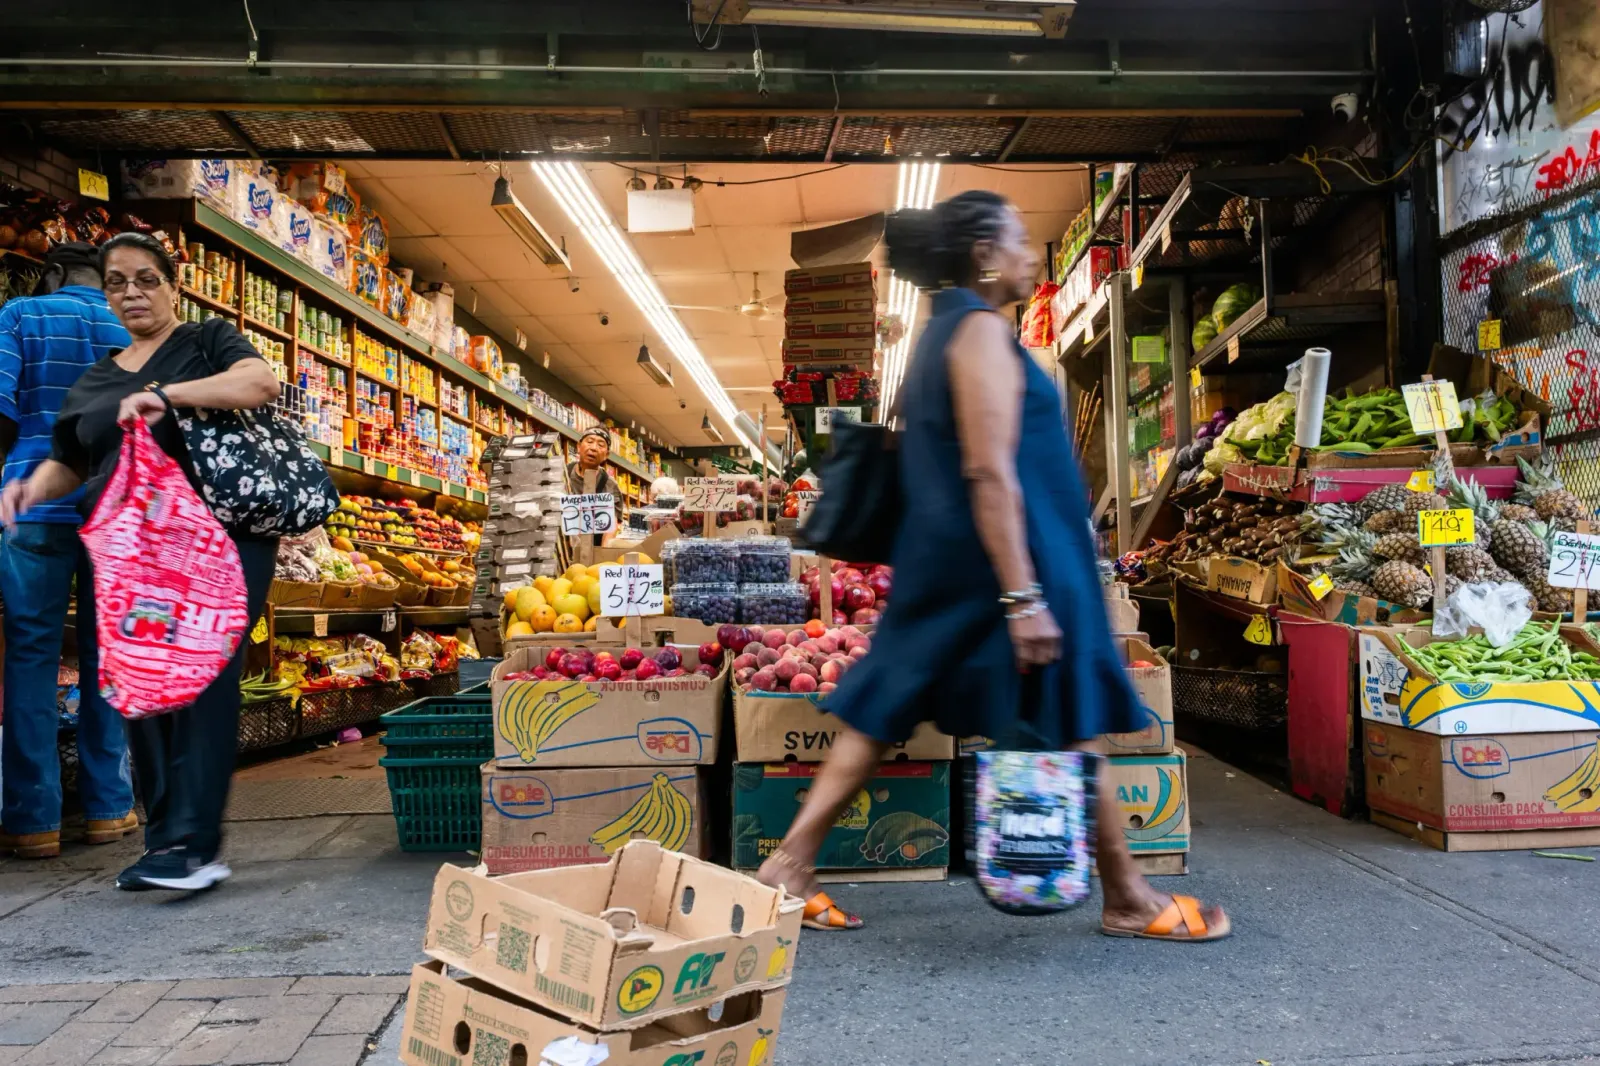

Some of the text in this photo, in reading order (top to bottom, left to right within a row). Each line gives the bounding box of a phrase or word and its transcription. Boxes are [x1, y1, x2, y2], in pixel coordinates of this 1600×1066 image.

[252, 187, 272, 209] Scott
[687, 477, 700, 485] Red
[563, 505, 587, 532] 2
[1424, 510, 1456, 518] OKRA
[605, 567, 623, 578] Red
[1554, 550, 1577, 577] 2
[1217, 573, 1252, 593] BANANAS
[607, 583, 624, 608] 5
[635, 581, 651, 604] 2
[600, 681, 633, 692] PACK
[646, 735, 690, 753] Dole
[1461, 745, 1502, 763] Dole
[500, 783, 545, 802] Dole
[1449, 802, 1546, 817] CONSUMER PACK
[487, 845, 590, 860] CONSUMER PACK
